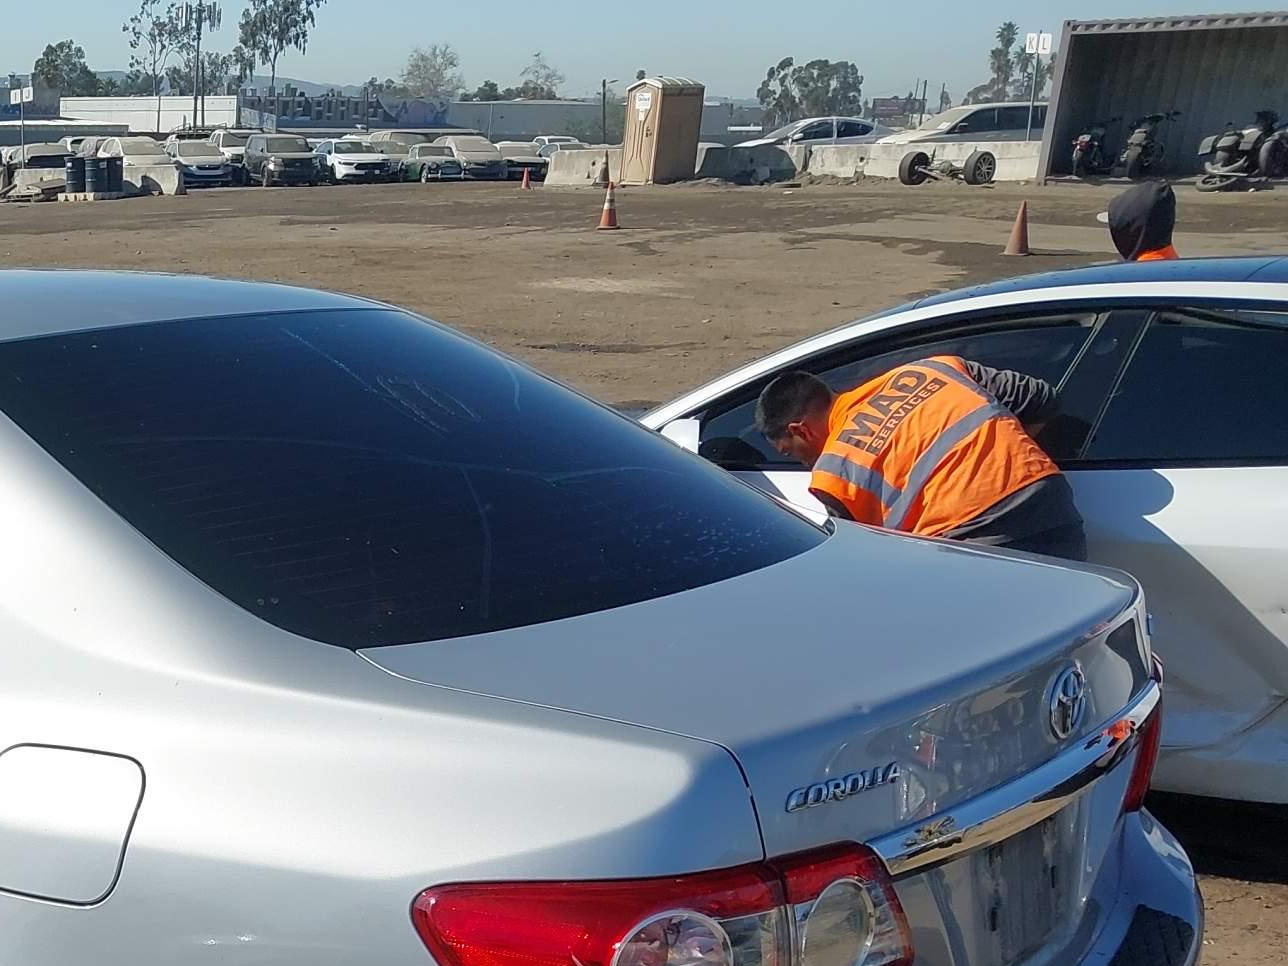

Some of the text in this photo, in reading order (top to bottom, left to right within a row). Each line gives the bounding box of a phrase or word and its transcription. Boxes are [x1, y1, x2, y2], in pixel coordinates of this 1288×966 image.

[836, 370, 927, 451] MAD
[872, 382, 941, 449] SERVICES
[785, 761, 901, 813] COROLLA
